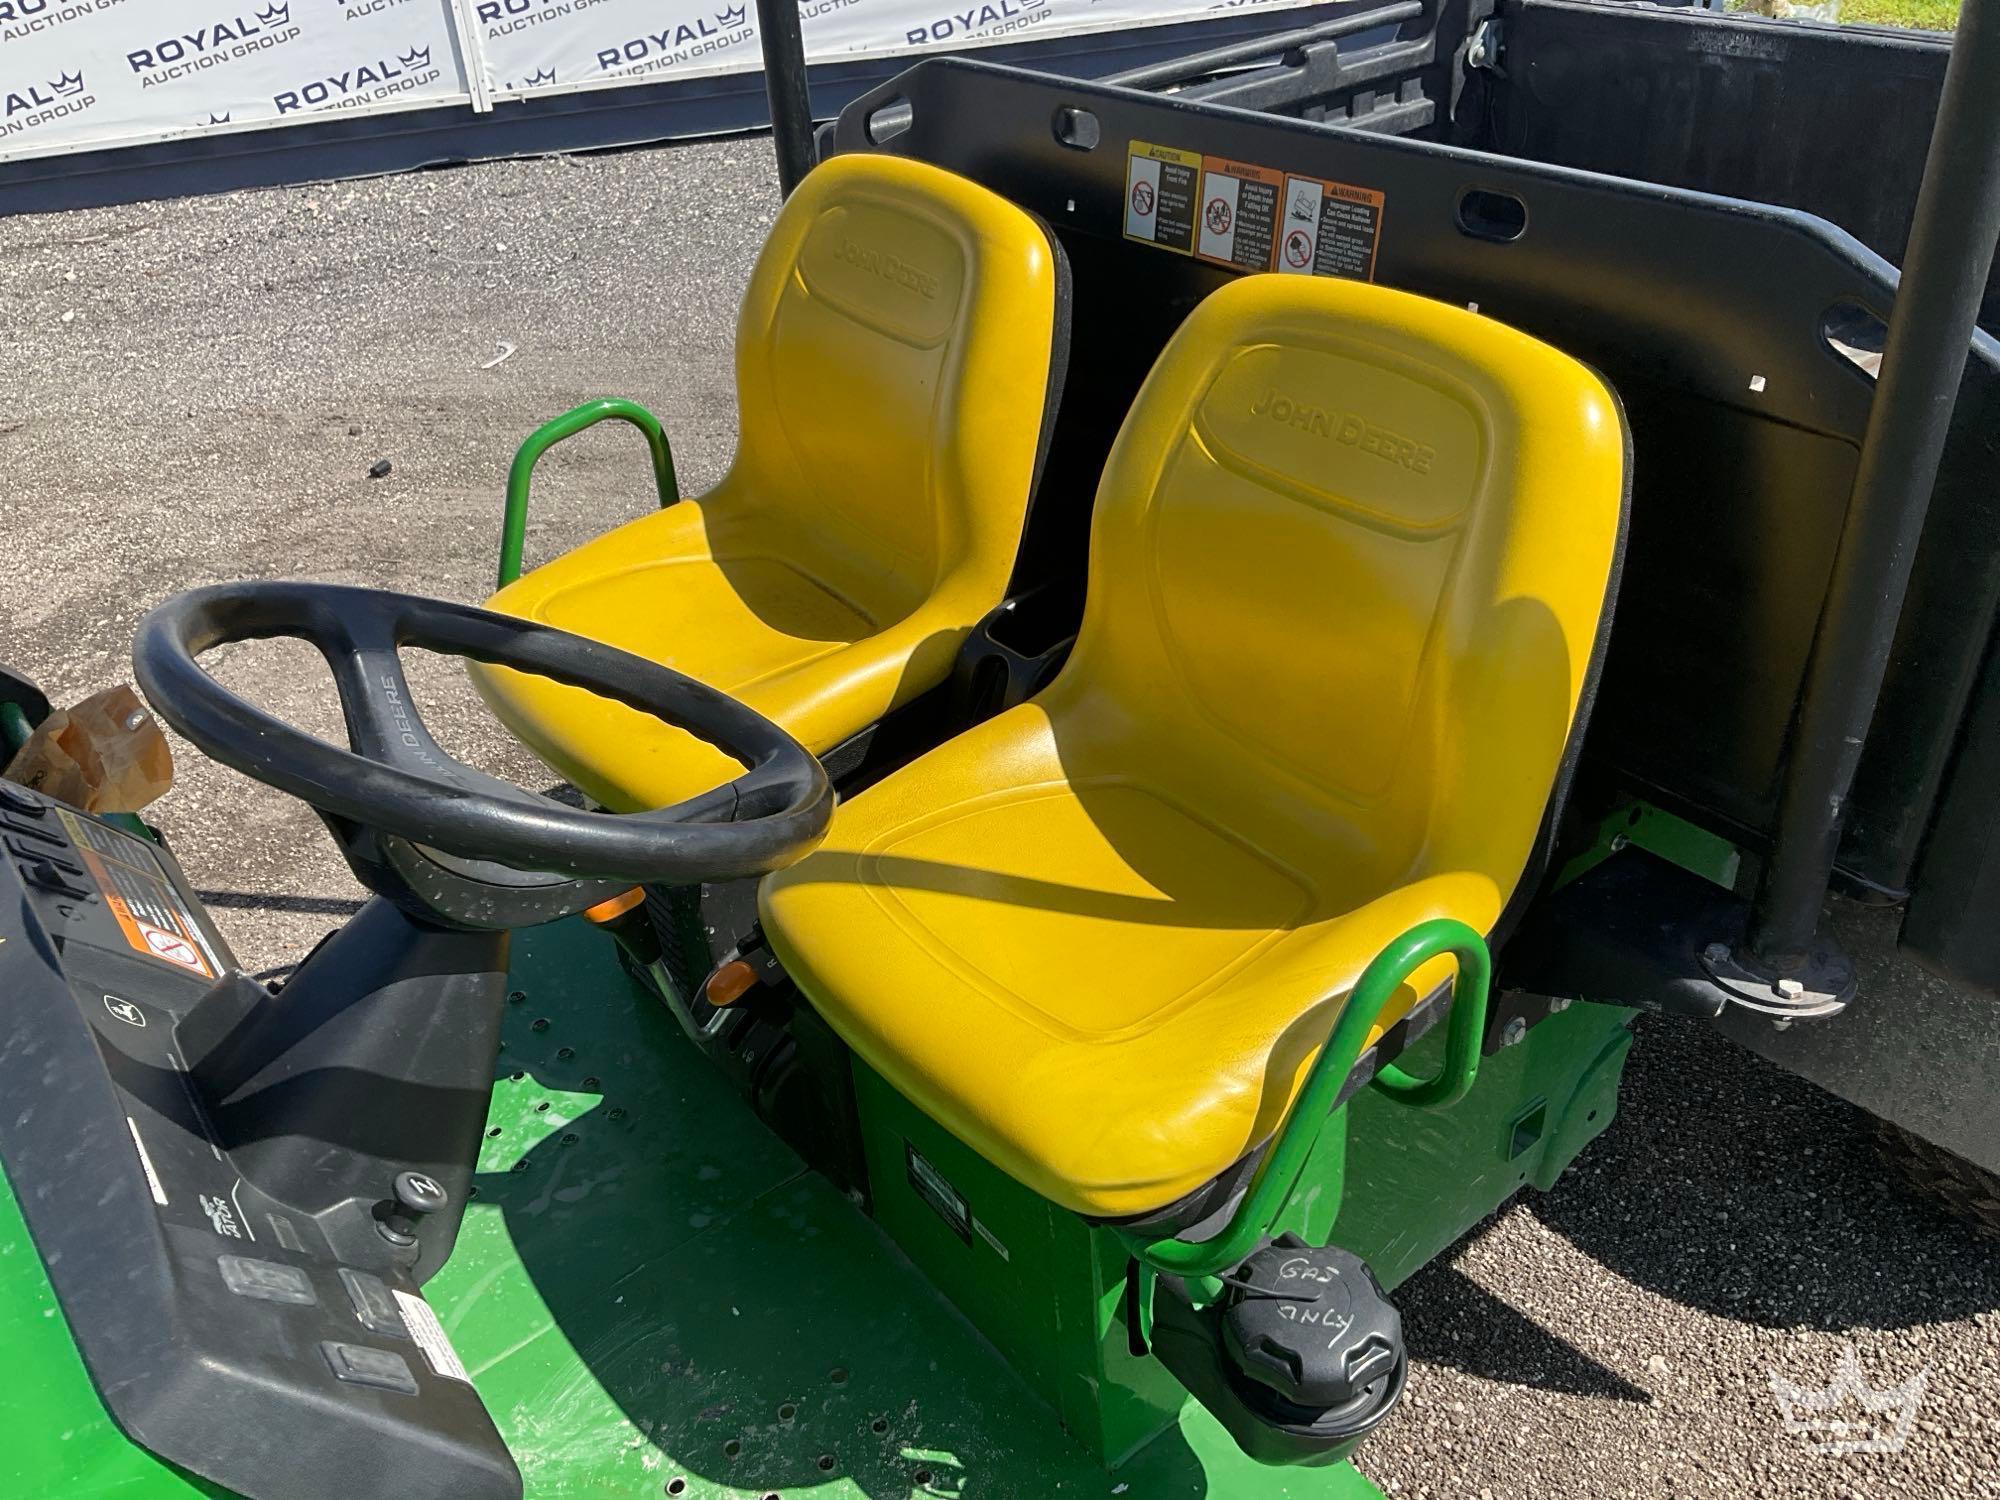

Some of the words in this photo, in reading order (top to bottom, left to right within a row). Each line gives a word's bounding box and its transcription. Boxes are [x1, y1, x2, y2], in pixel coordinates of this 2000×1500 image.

[4, 2, 93, 42] AUCTION
[489, 3, 571, 40] AUCTION
[906, 0, 1019, 45] ROYAL
[993, 8, 1052, 36] GROUP
[127, 17, 261, 73] ROYAL
[142, 50, 229, 89] AUCTION
[232, 26, 301, 58] GROUP
[597, 19, 718, 70] ROYAL
[690, 28, 754, 57] GROUP
[273, 61, 402, 114] ROYAL
[374, 69, 440, 99] GROUP
[26, 95, 96, 127] GROUP
[1231, 164, 1262, 180] WARNING
[1338, 186, 1373, 204] WARNING
[833, 238, 880, 276] JOHN
[1250, 389, 1335, 440] JOHN
[1335, 415, 1437, 476] DEERE
[380, 675, 420, 748] DEERE
[766, 958, 777, 969] R
[1279, 1257, 1340, 1283] GAS
[1277, 1305, 1355, 1349] ONLY
